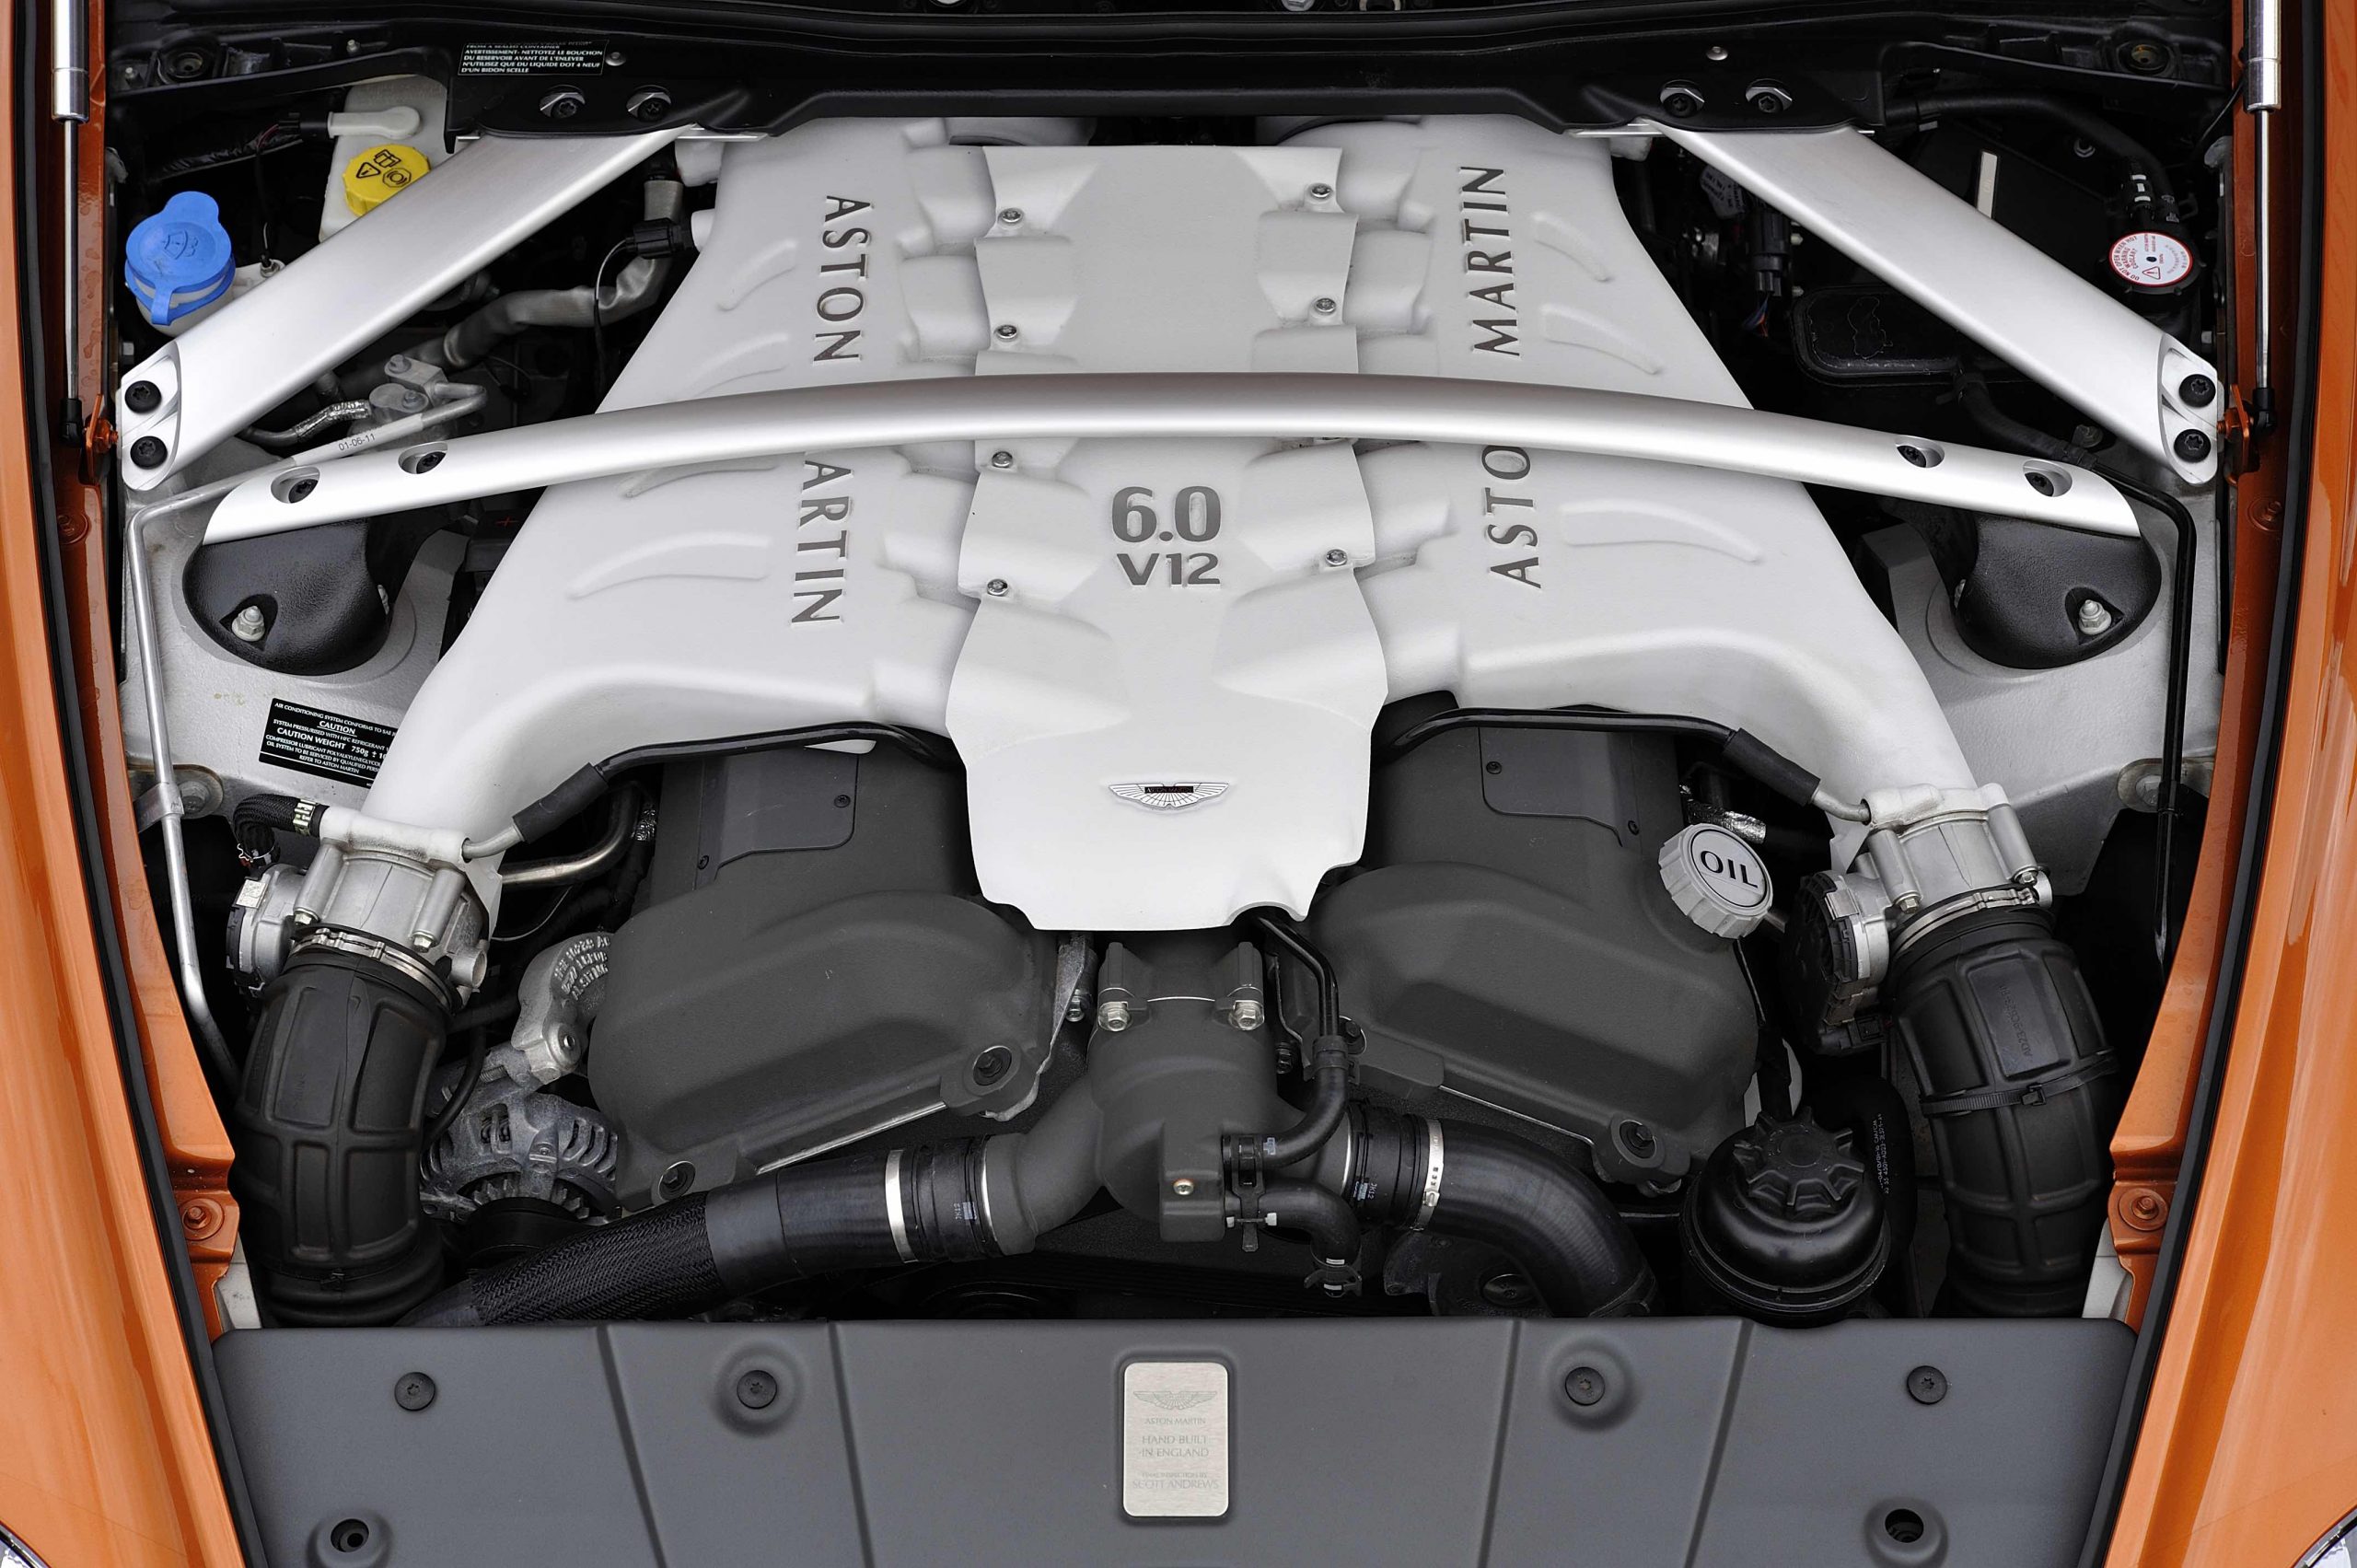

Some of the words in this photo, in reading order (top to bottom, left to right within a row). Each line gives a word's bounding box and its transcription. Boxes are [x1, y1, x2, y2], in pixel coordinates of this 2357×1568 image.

[1460, 167, 1520, 356] MARTIN
[814, 196, 871, 362] ASTON
[1111, 485, 1222, 543] 6.0
[1481, 446, 1541, 589] ASTO
[792, 460, 852, 623] ARTIN
[1116, 552, 1221, 586] V12
[284, 704, 324, 719] CONDITIONING
[324, 714, 343, 724] SYSTEM
[343, 719, 374, 731] CONFORMS
[319, 720, 356, 735] CAUTION
[265, 734, 299, 747] COMPRESSOR
[298, 742, 327, 754] LUBRICANT
[273, 718, 293, 728] SYSTEM
[292, 723, 326, 737] PRESSURISED
[325, 731, 341, 740] WITH
[351, 738, 386, 751] REFRIGERANT
[276, 726, 314, 742] CAUTION
[314, 736, 347, 750] WEIGHT
[351, 745, 369, 758] 750g
[275, 742, 295, 752] SYSTEM
[308, 750, 333, 761] SERVICED
[340, 759, 366, 770] QUALIFIED
[298, 754, 315, 763] REFER
[321, 761, 340, 770] ASTON
[339, 765, 360, 774] MARTIN
[1700, 850, 1759, 889] OIL
[1144, 1417, 1173, 1425] ASTON
[1174, 1417, 1206, 1425] MARTIN
[1142, 1435, 1176, 1445] HAND
[1178, 1435, 1208, 1445] BUILT
[1142, 1448, 1154, 1458] IN
[1156, 1448, 1210, 1458] ENGLAND
[1132, 1480, 1165, 1489] SCOTT
[1167, 1480, 1219, 1489] ANDREWS
